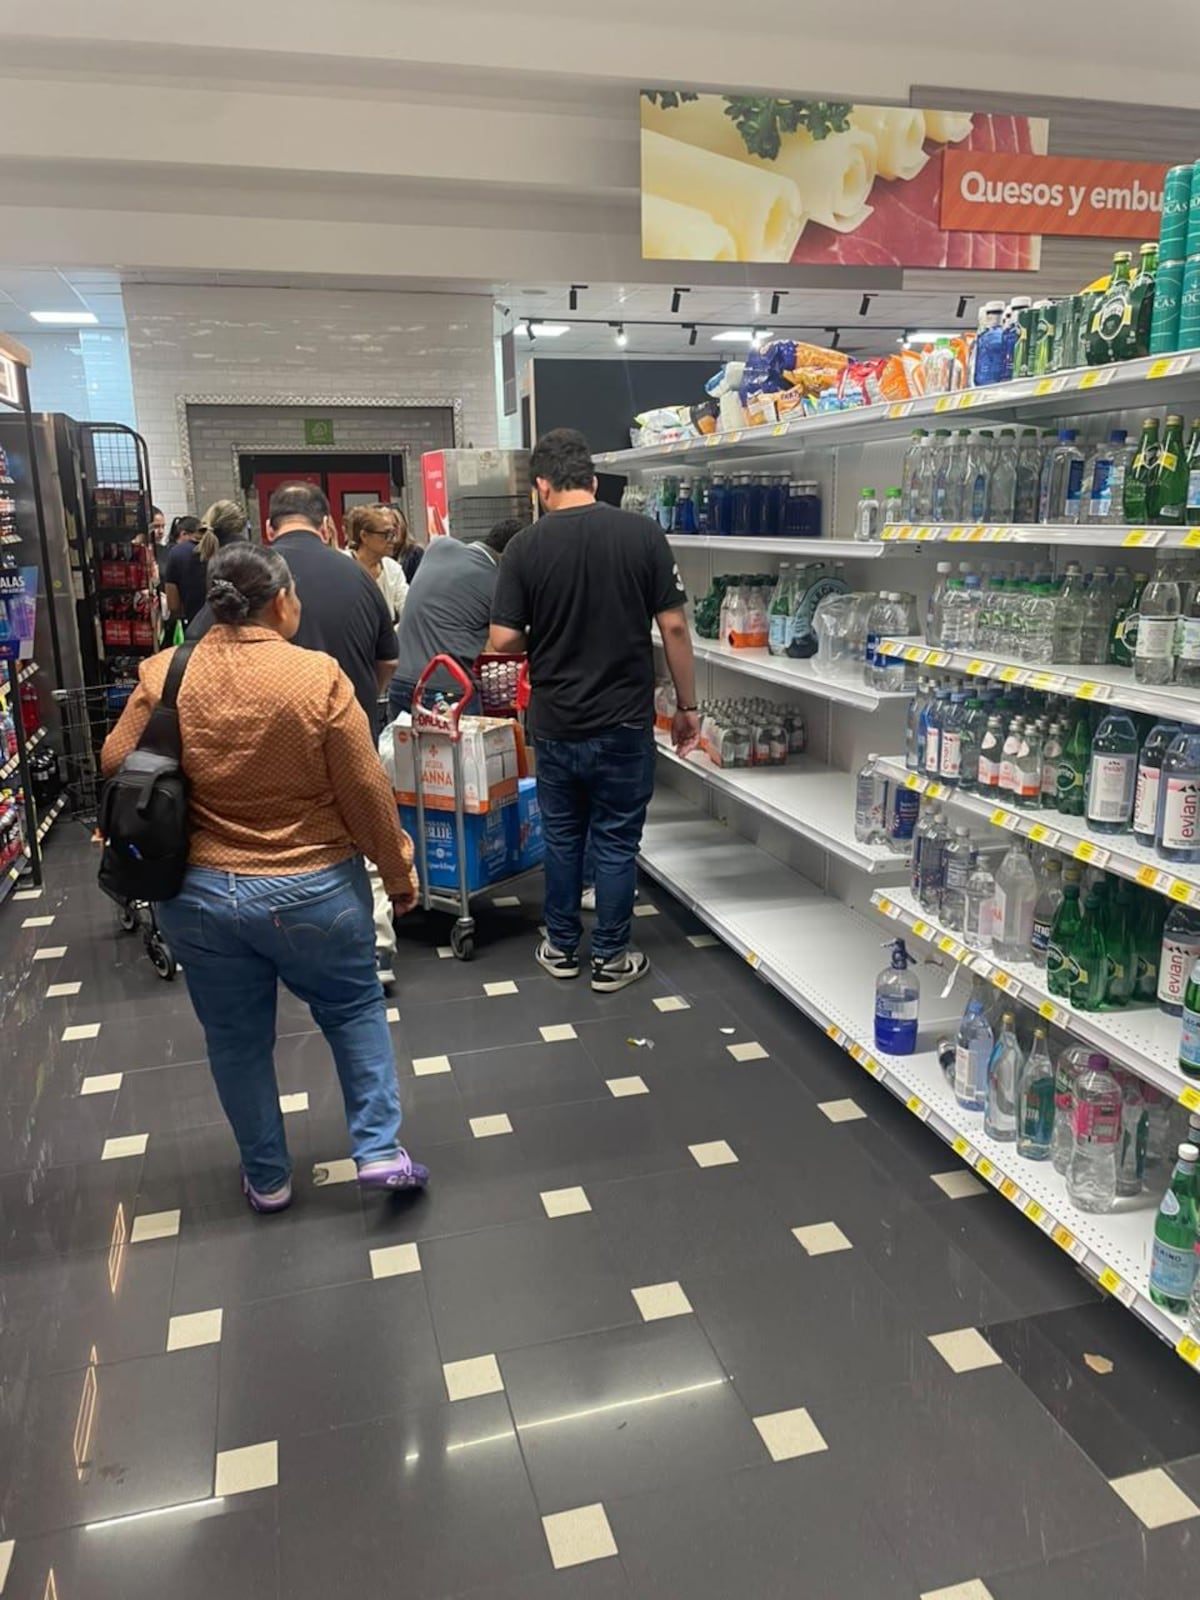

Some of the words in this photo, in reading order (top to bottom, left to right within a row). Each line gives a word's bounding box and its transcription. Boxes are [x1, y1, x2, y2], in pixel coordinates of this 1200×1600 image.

[960, 171, 1063, 206] Quesos
[1068, 186, 1086, 216] y
[1090, 180, 1162, 212] embu
[1181, 794, 1197, 838] evian
[1167, 955, 1183, 994] evian
